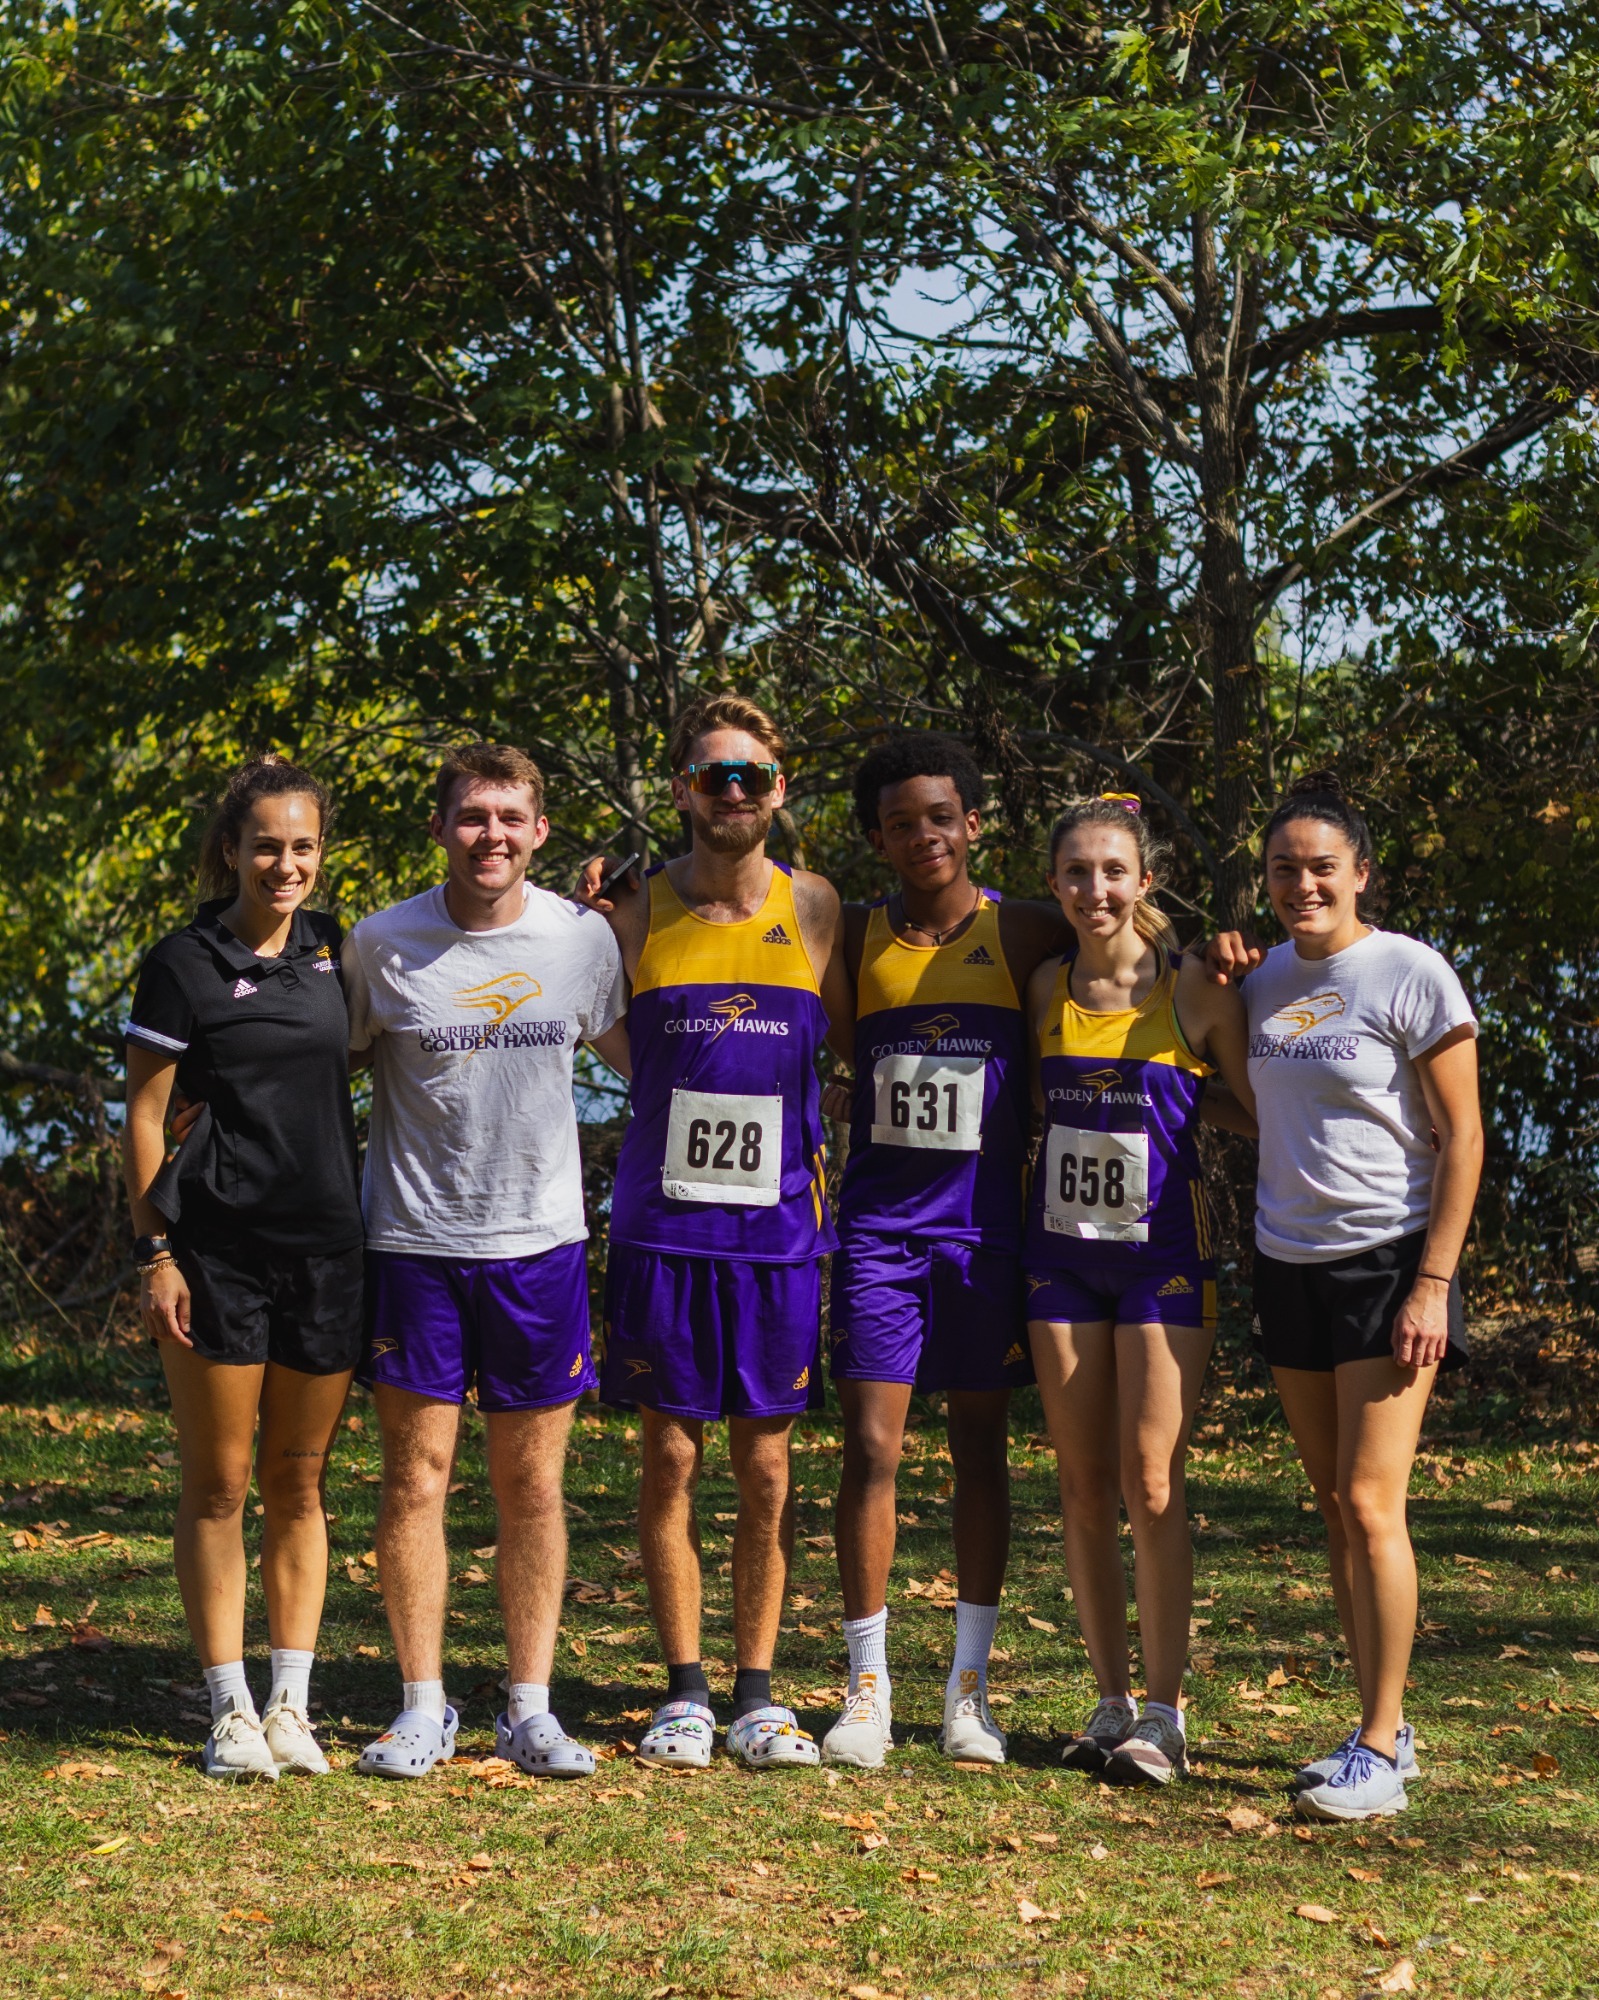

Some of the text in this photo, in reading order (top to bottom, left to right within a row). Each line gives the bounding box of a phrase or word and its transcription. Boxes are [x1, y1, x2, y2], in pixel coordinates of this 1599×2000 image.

[762, 935, 791, 945] adidas
[963, 957, 995, 965] adidas
[233, 986, 258, 998] adidas
[418, 1020, 566, 1040] LAURIER BRANTFORD
[664, 1018, 789, 1036] GOLDEN HAWKS
[420, 1032, 566, 1052] GOLDEN HAWKS
[871, 1038, 992, 1059] GOLDEN HAWKS
[1282, 1033, 1360, 1048] BRANTFORD
[1248, 1044, 1357, 1060] OLDEN HAWKS
[890, 1081, 958, 1132] 631
[1101, 1091, 1153, 1107] HAWKS
[687, 1118, 763, 1172] 628
[1060, 1152, 1125, 1209] 658
[1156, 1285, 1194, 1297] adidas
